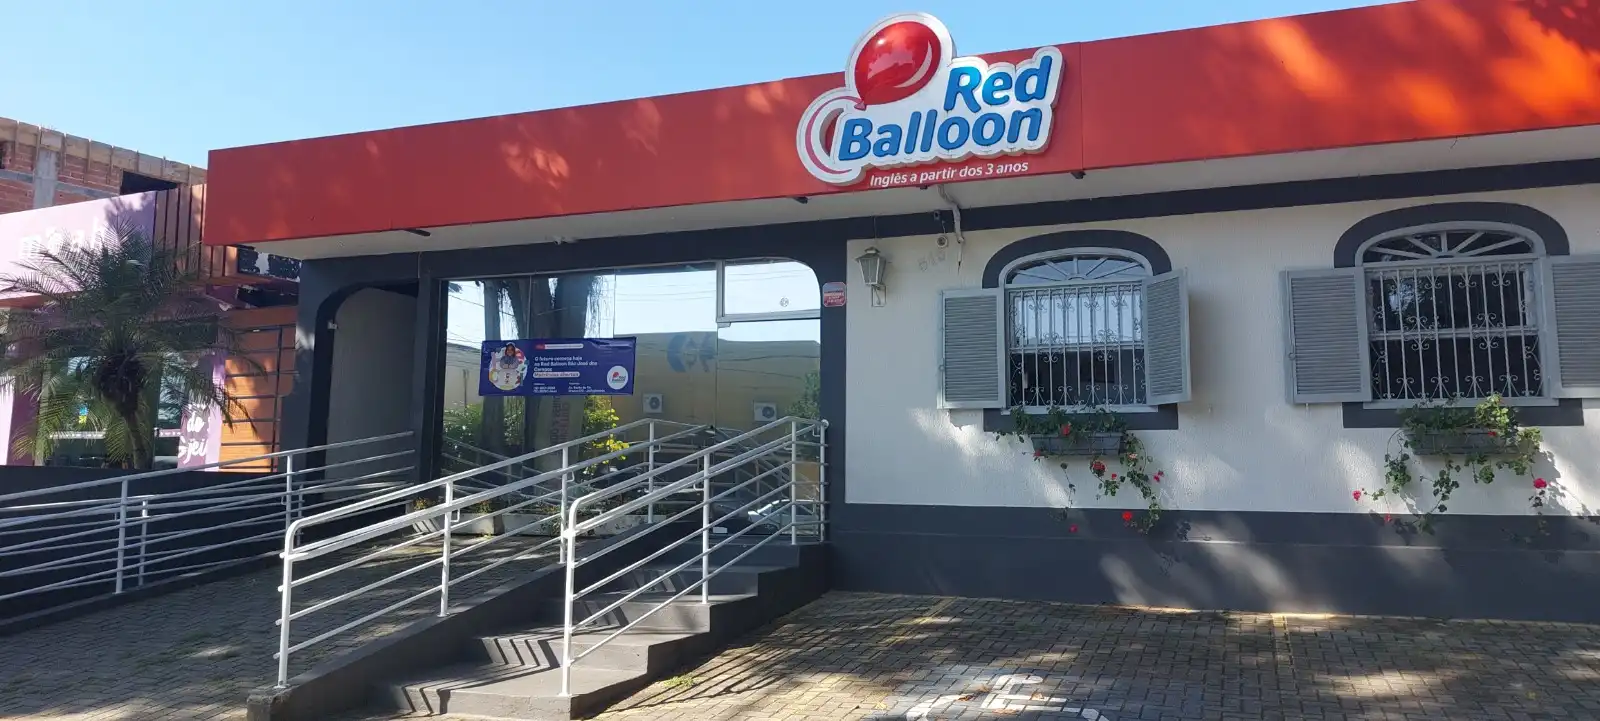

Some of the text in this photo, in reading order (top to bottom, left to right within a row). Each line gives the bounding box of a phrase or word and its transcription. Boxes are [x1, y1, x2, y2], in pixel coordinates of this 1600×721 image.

[943, 55, 1053, 114] Red
[838, 108, 1043, 161] Balloon
[870, 162, 1029, 188] Inglês a partir dos 3 anos
